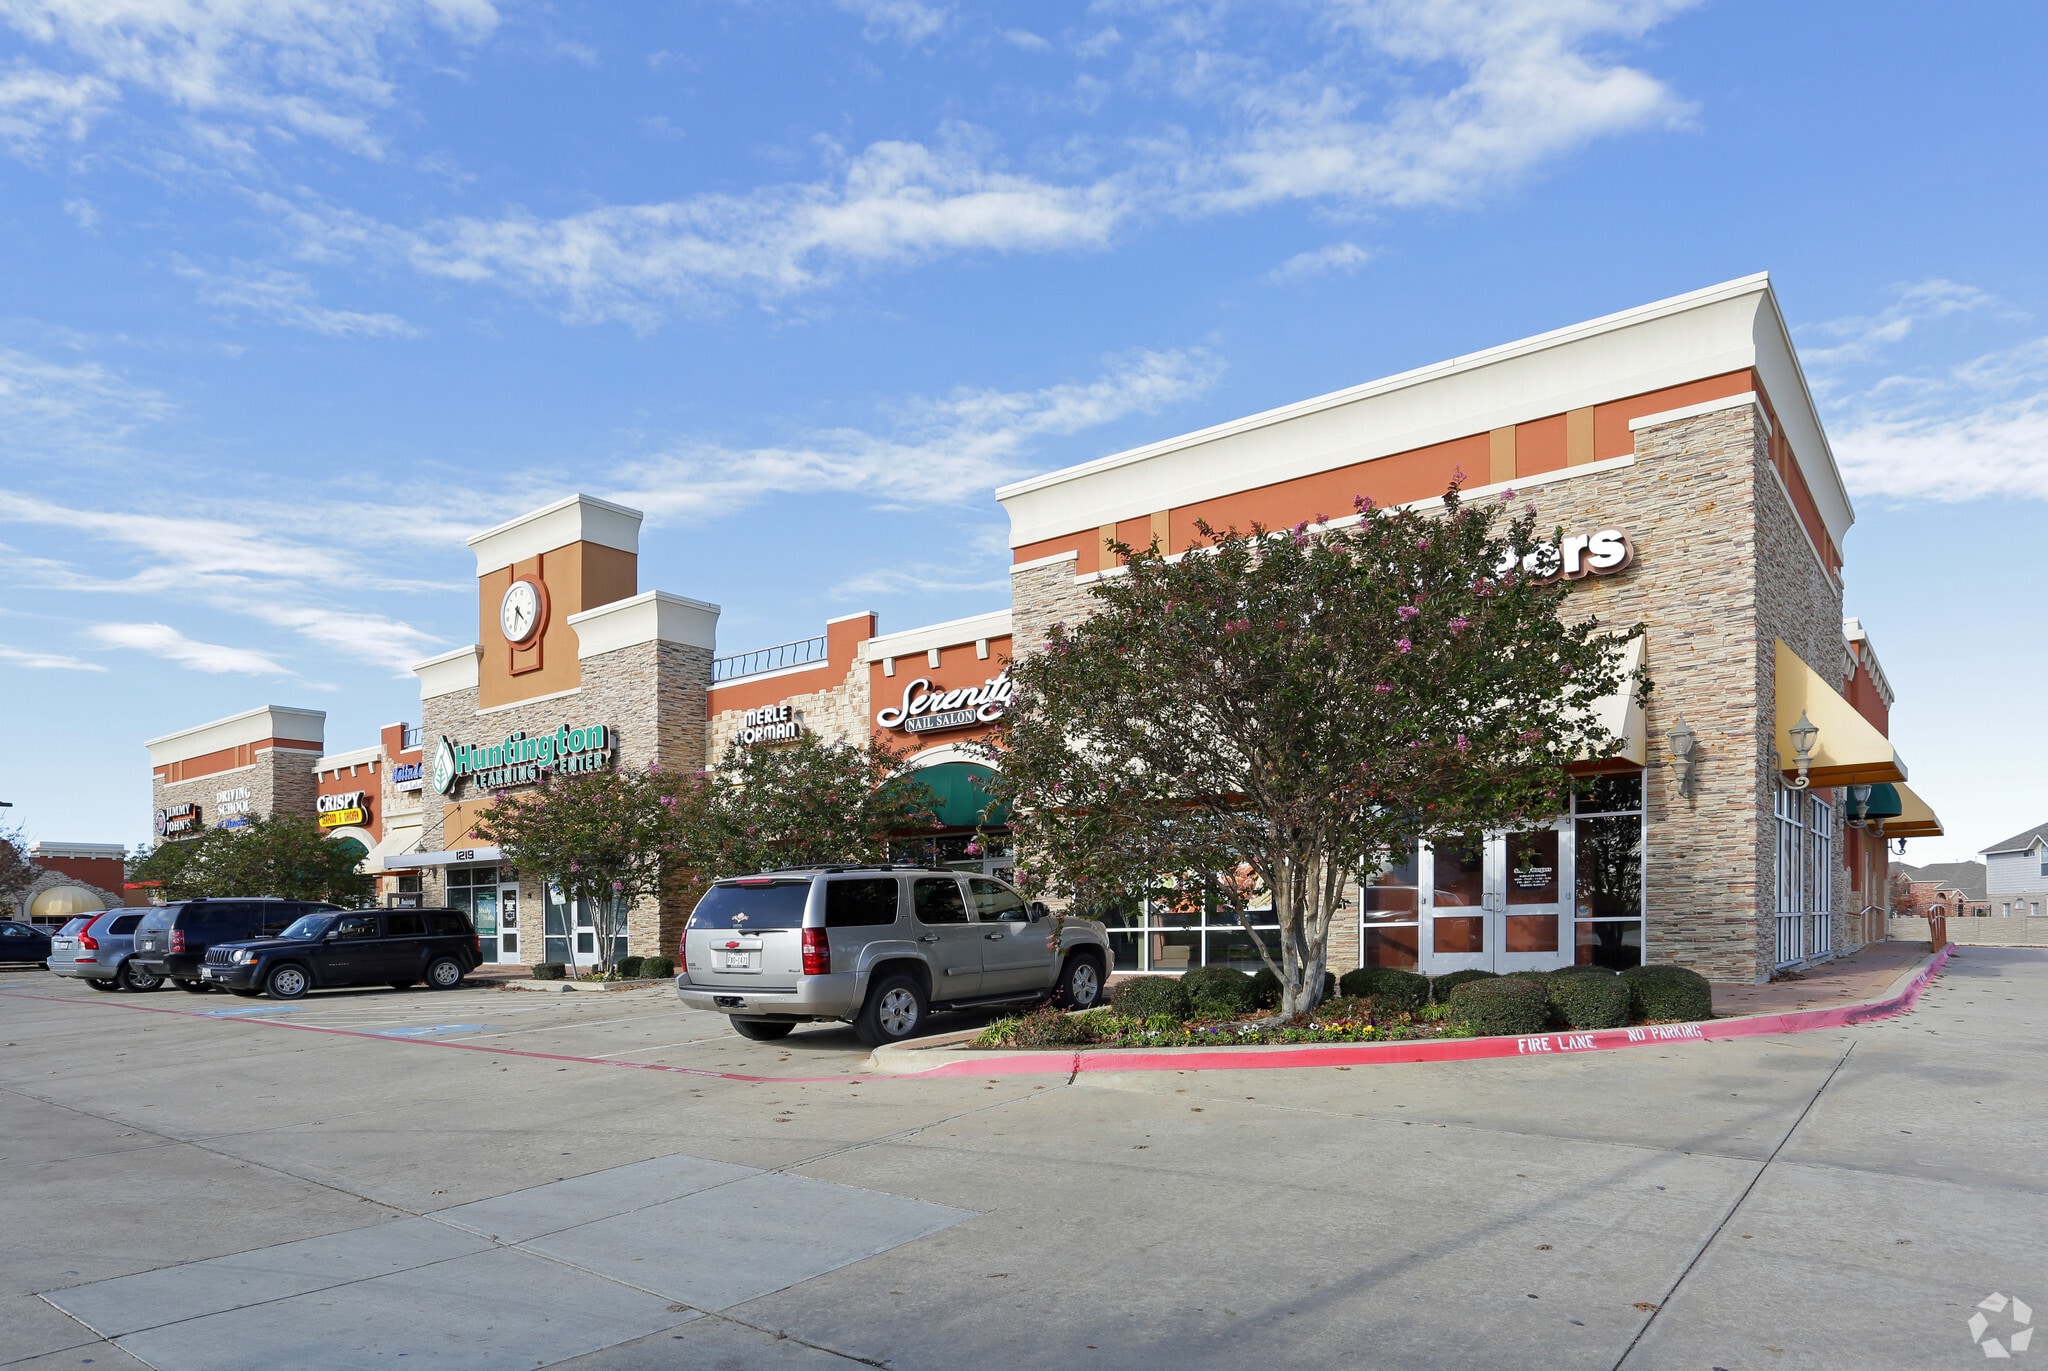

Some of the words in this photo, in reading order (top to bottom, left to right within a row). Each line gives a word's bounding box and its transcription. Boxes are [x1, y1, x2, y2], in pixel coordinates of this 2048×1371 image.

[876, 666, 1014, 728] Serenity
[744, 705, 788, 727] MERLE
[907, 719, 934, 732] NAIL
[936, 709, 974, 727] SALON
[455, 723, 604, 767] Huntington
[473, 764, 537, 789] LEARNING
[552, 752, 603, 775] CENTER
[216, 786, 251, 803] DRIVING
[317, 792, 361, 812] CRISPY
[166, 804, 190, 820] JIMMY
[217, 800, 250, 816] SCHOOL
[166, 819, 191, 836] JOHN'S
[455, 850, 475, 861] 1219
[1518, 1037, 1551, 1053] FIRE
[1558, 1034, 1597, 1050] LANE
[1627, 1029, 1646, 1042] NO
[1651, 1024, 1703, 1040] PARKING
